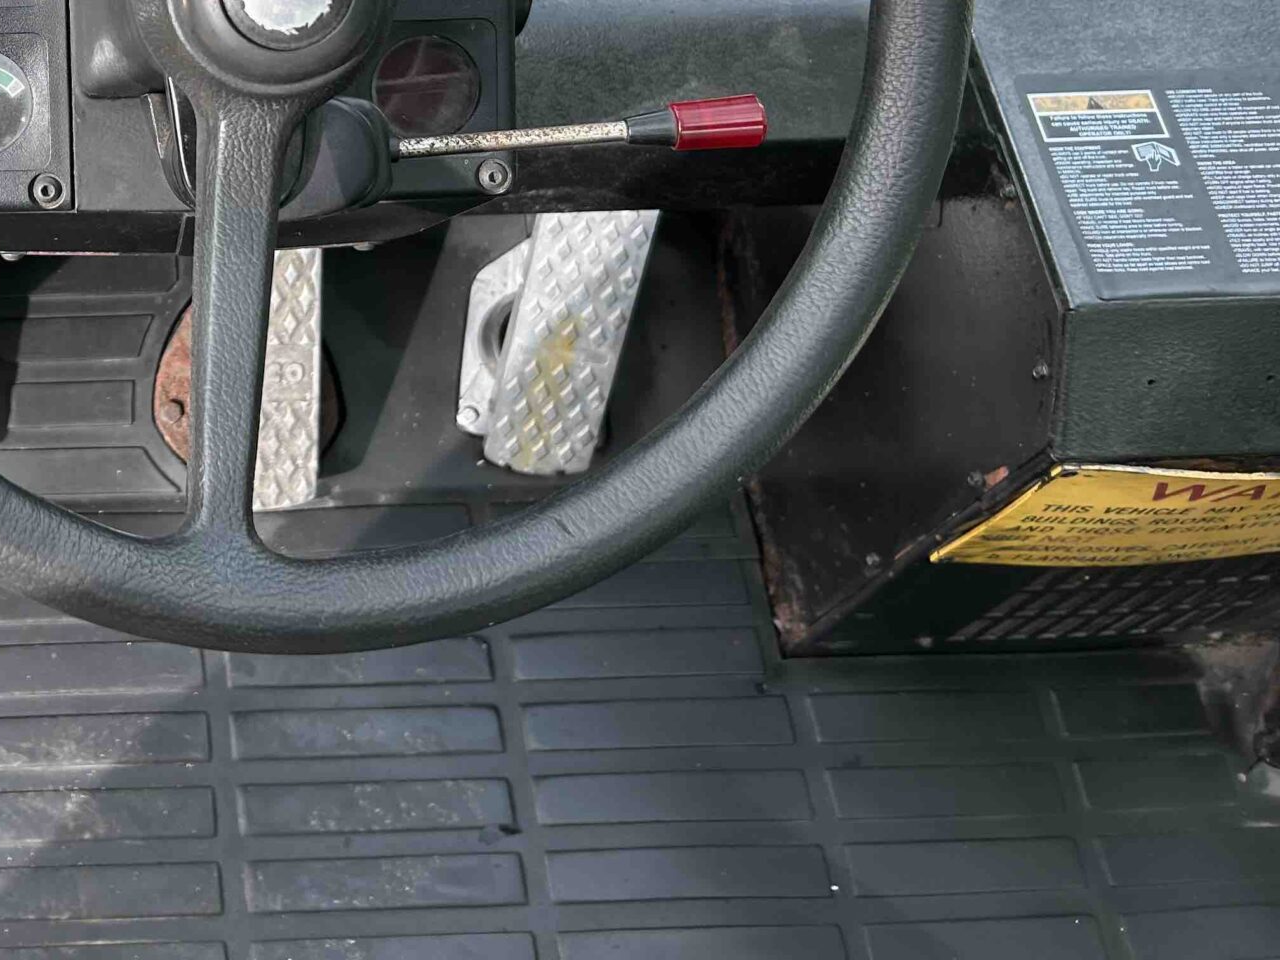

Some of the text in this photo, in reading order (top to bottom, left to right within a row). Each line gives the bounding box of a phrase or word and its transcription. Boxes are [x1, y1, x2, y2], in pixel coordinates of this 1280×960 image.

[1152, 482, 1280, 502] WA
[1042, 504, 1093, 513] THIS
[1103, 506, 1197, 515] VEHICLE
[1021, 515, 1138, 526] BUILDINGS
